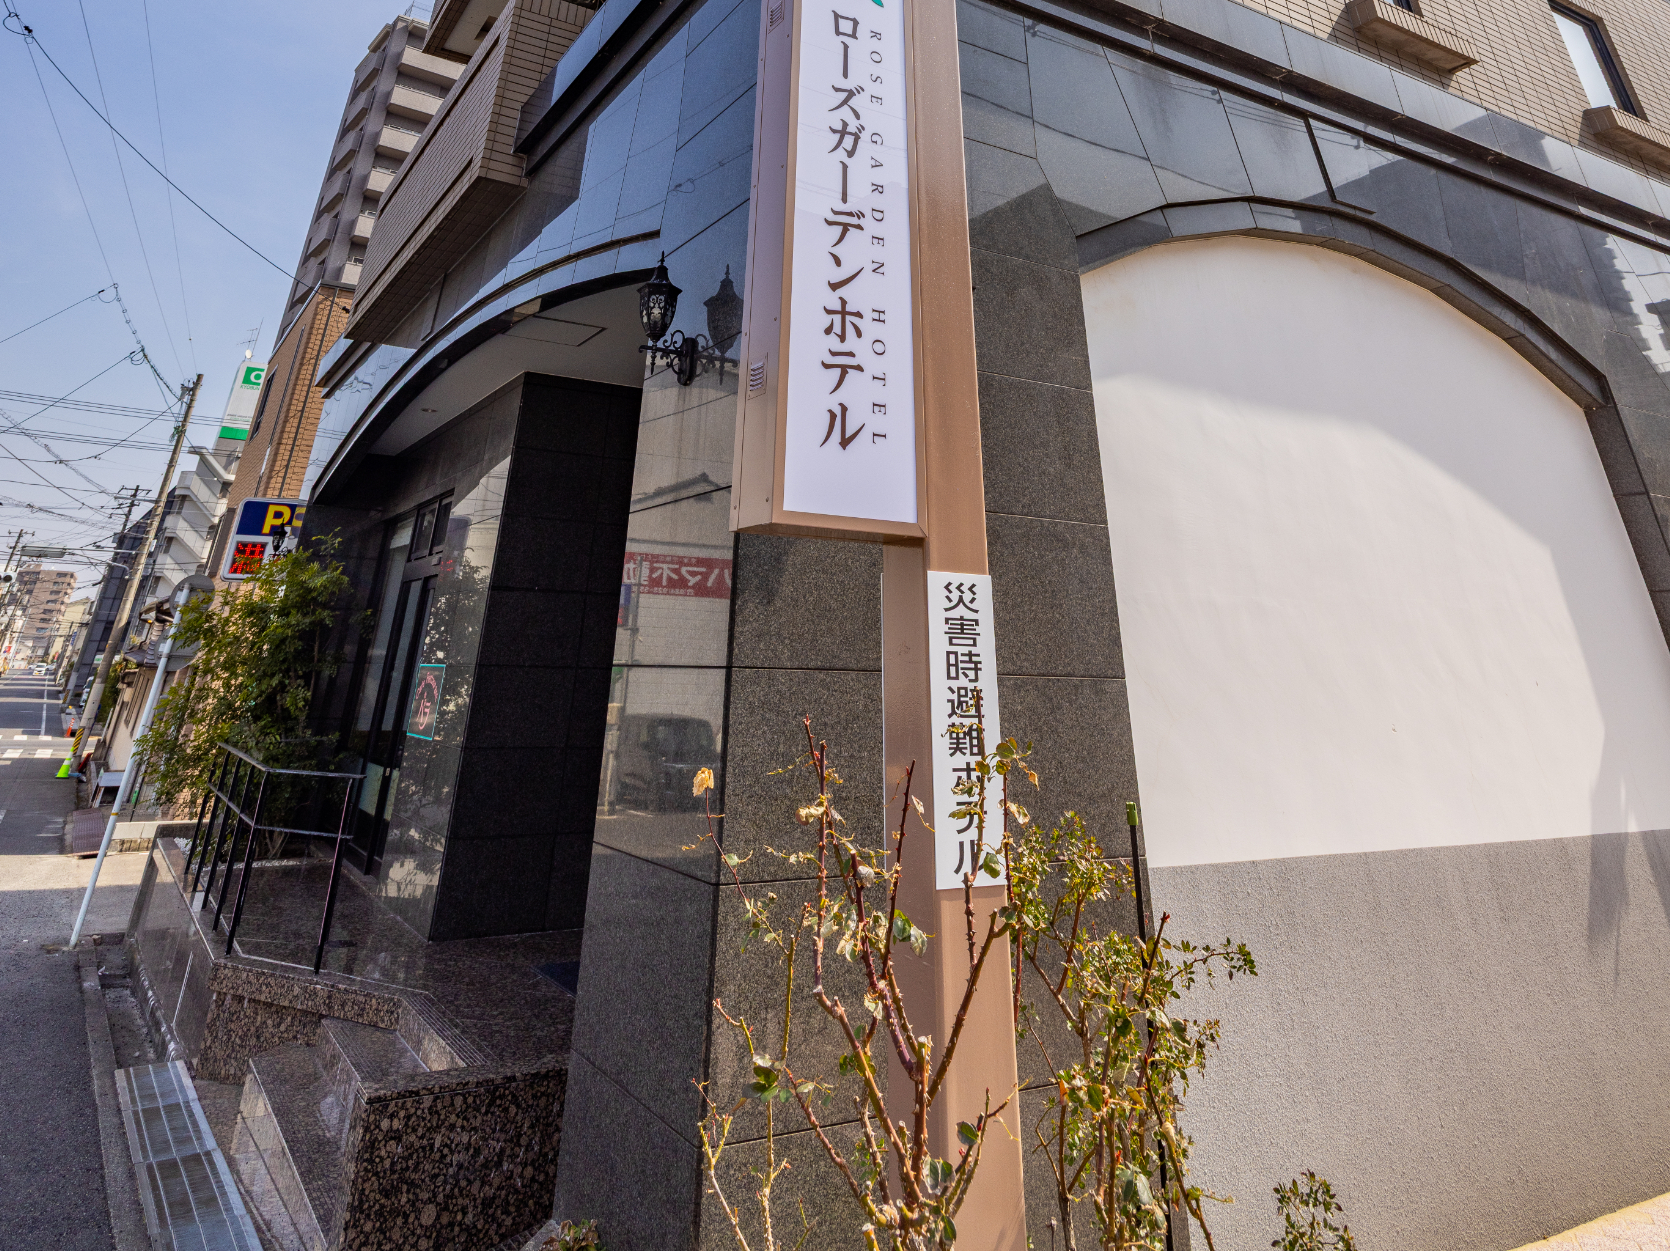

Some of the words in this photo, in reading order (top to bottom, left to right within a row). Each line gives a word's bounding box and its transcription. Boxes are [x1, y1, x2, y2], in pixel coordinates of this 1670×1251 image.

[869, 28, 883, 106] ROSE
[820, 9, 866, 451] ローズガーデンホテル
[870, 131, 885, 277] GARDEN
[871, 307, 887, 445] HOTEL
[942, 580, 987, 876] 災害時避難ホテル
